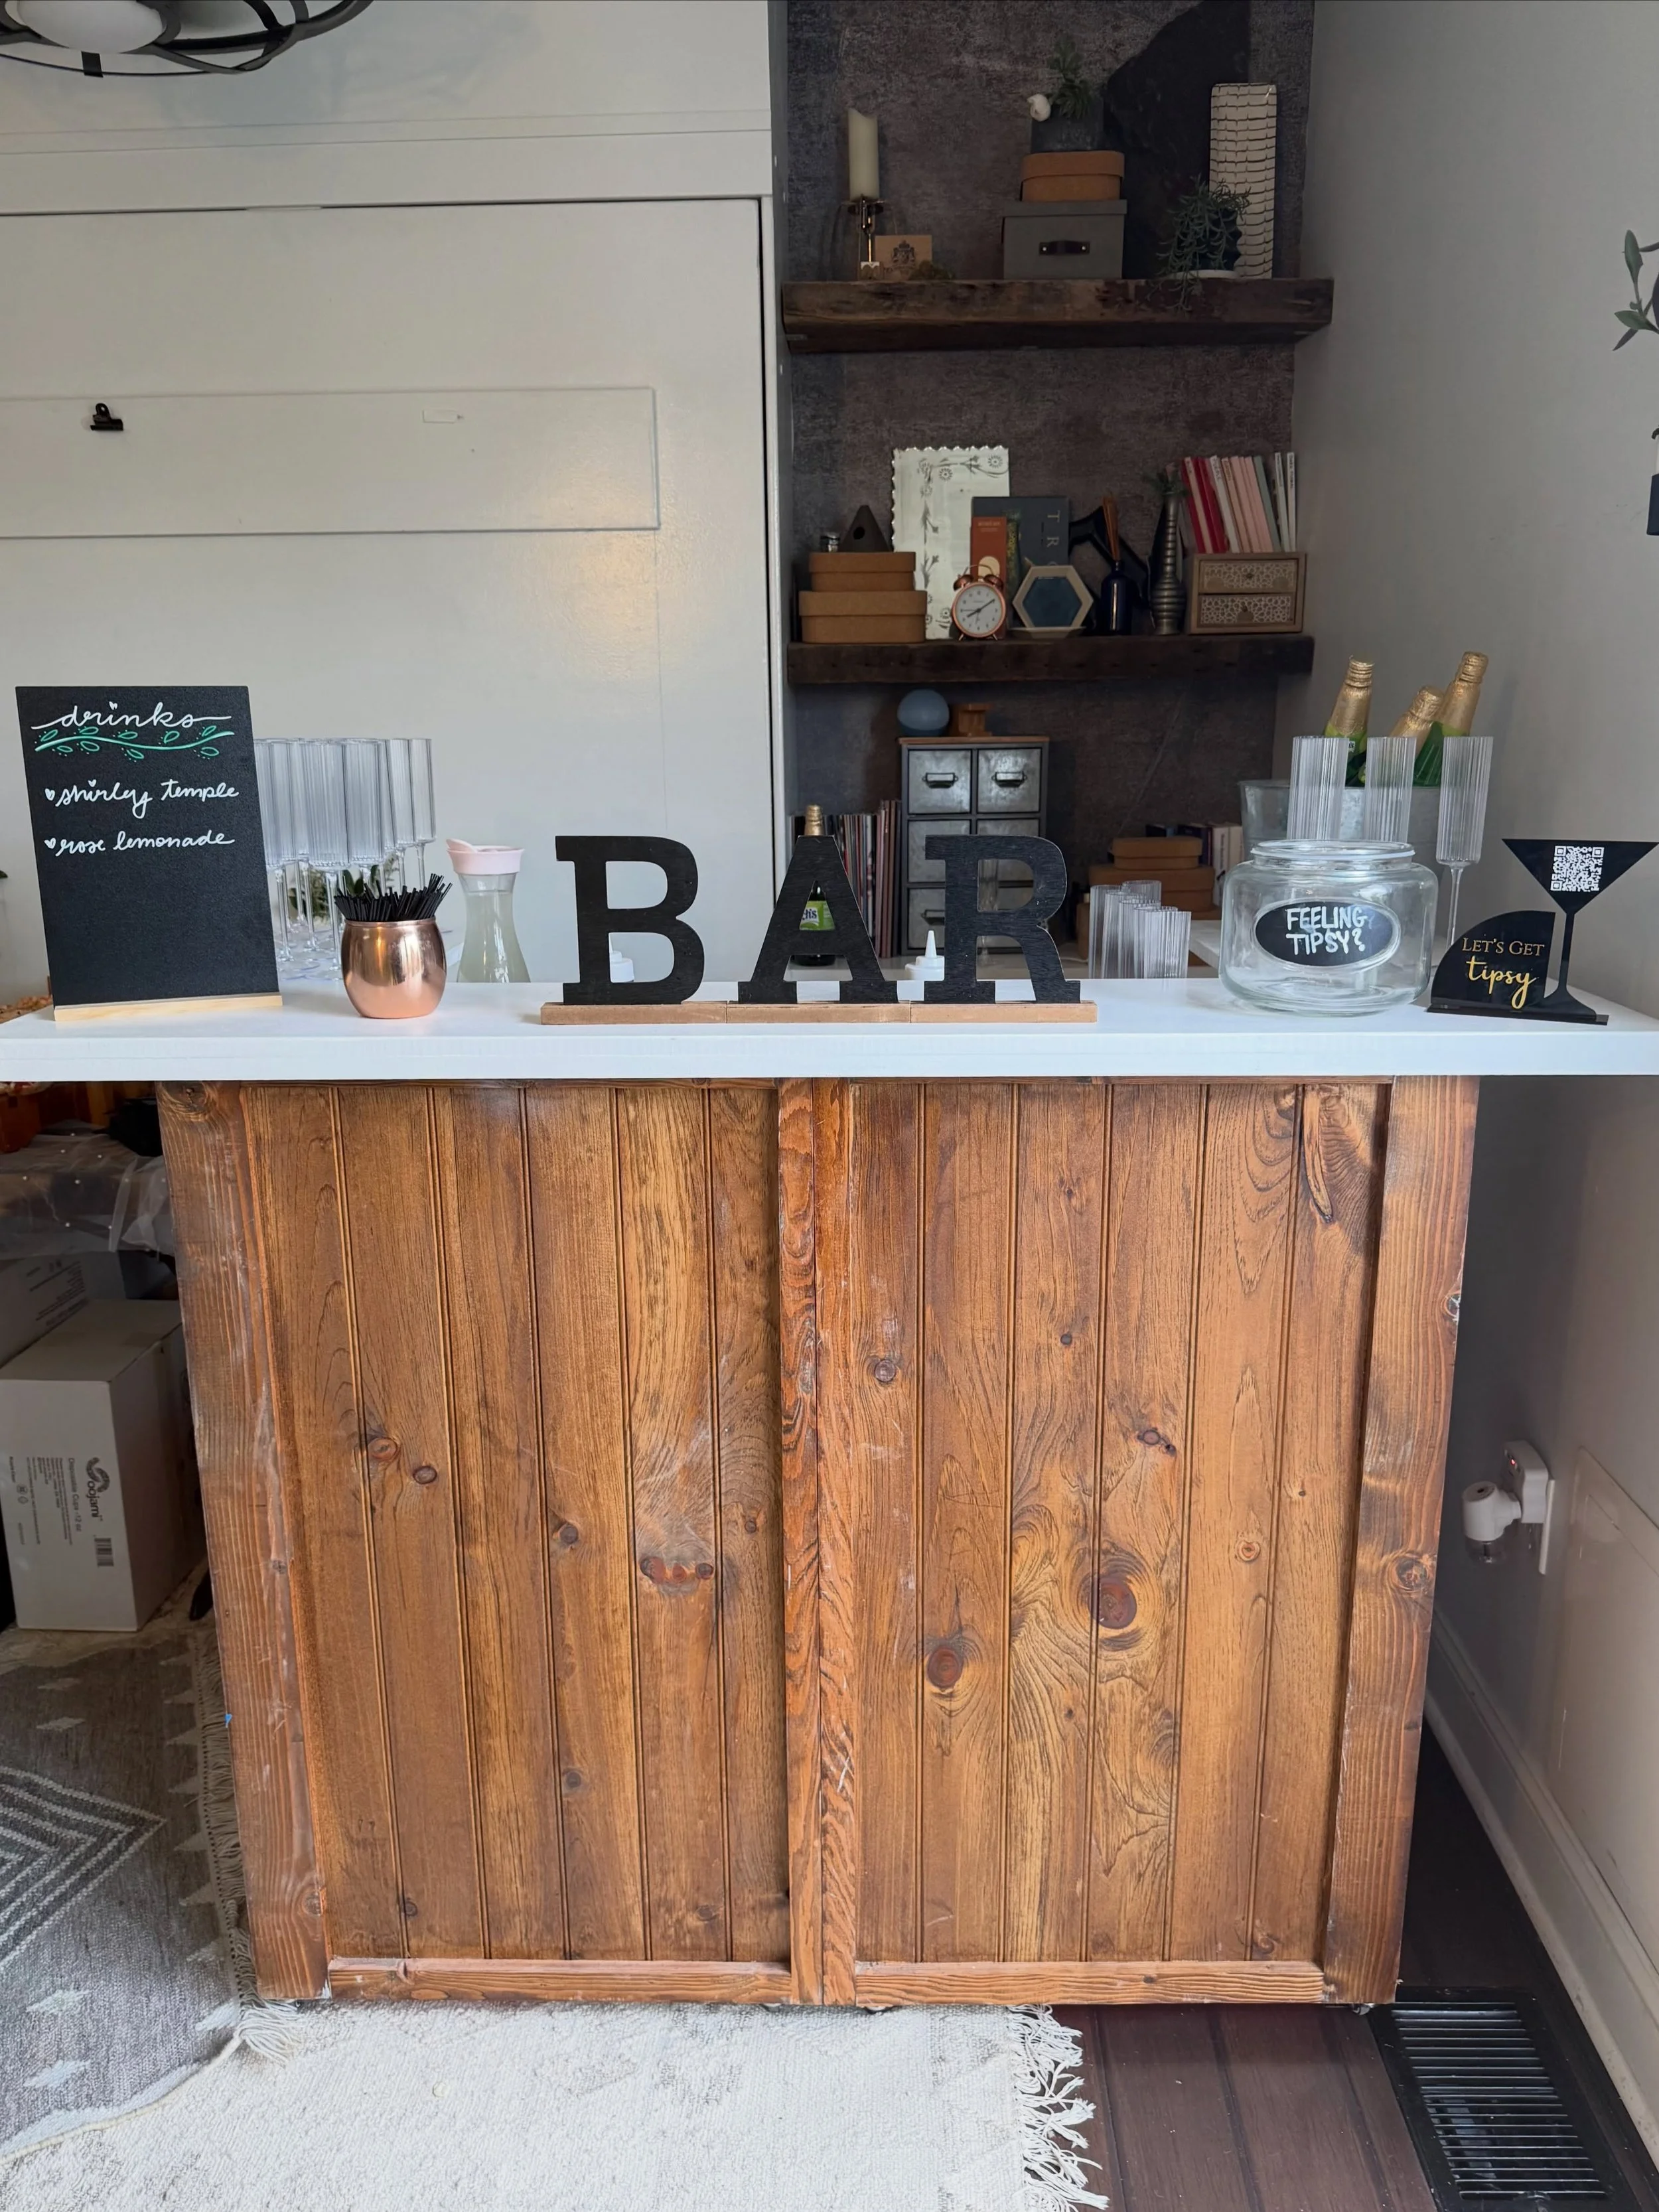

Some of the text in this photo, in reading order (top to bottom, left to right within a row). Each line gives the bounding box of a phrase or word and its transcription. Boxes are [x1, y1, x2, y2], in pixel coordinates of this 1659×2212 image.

[31, 701, 232, 729] drinks
[55, 779, 239, 819] shirley temple
[56, 830, 235, 857] rose lemonade
[555, 835, 1081, 1005] BAR
[1285, 905, 1368, 931] FEELING
[1285, 928, 1366, 956] TIPSY?
[1461, 936, 1546, 956] LET'S GET
[1466, 956, 1538, 1009] tipsy
